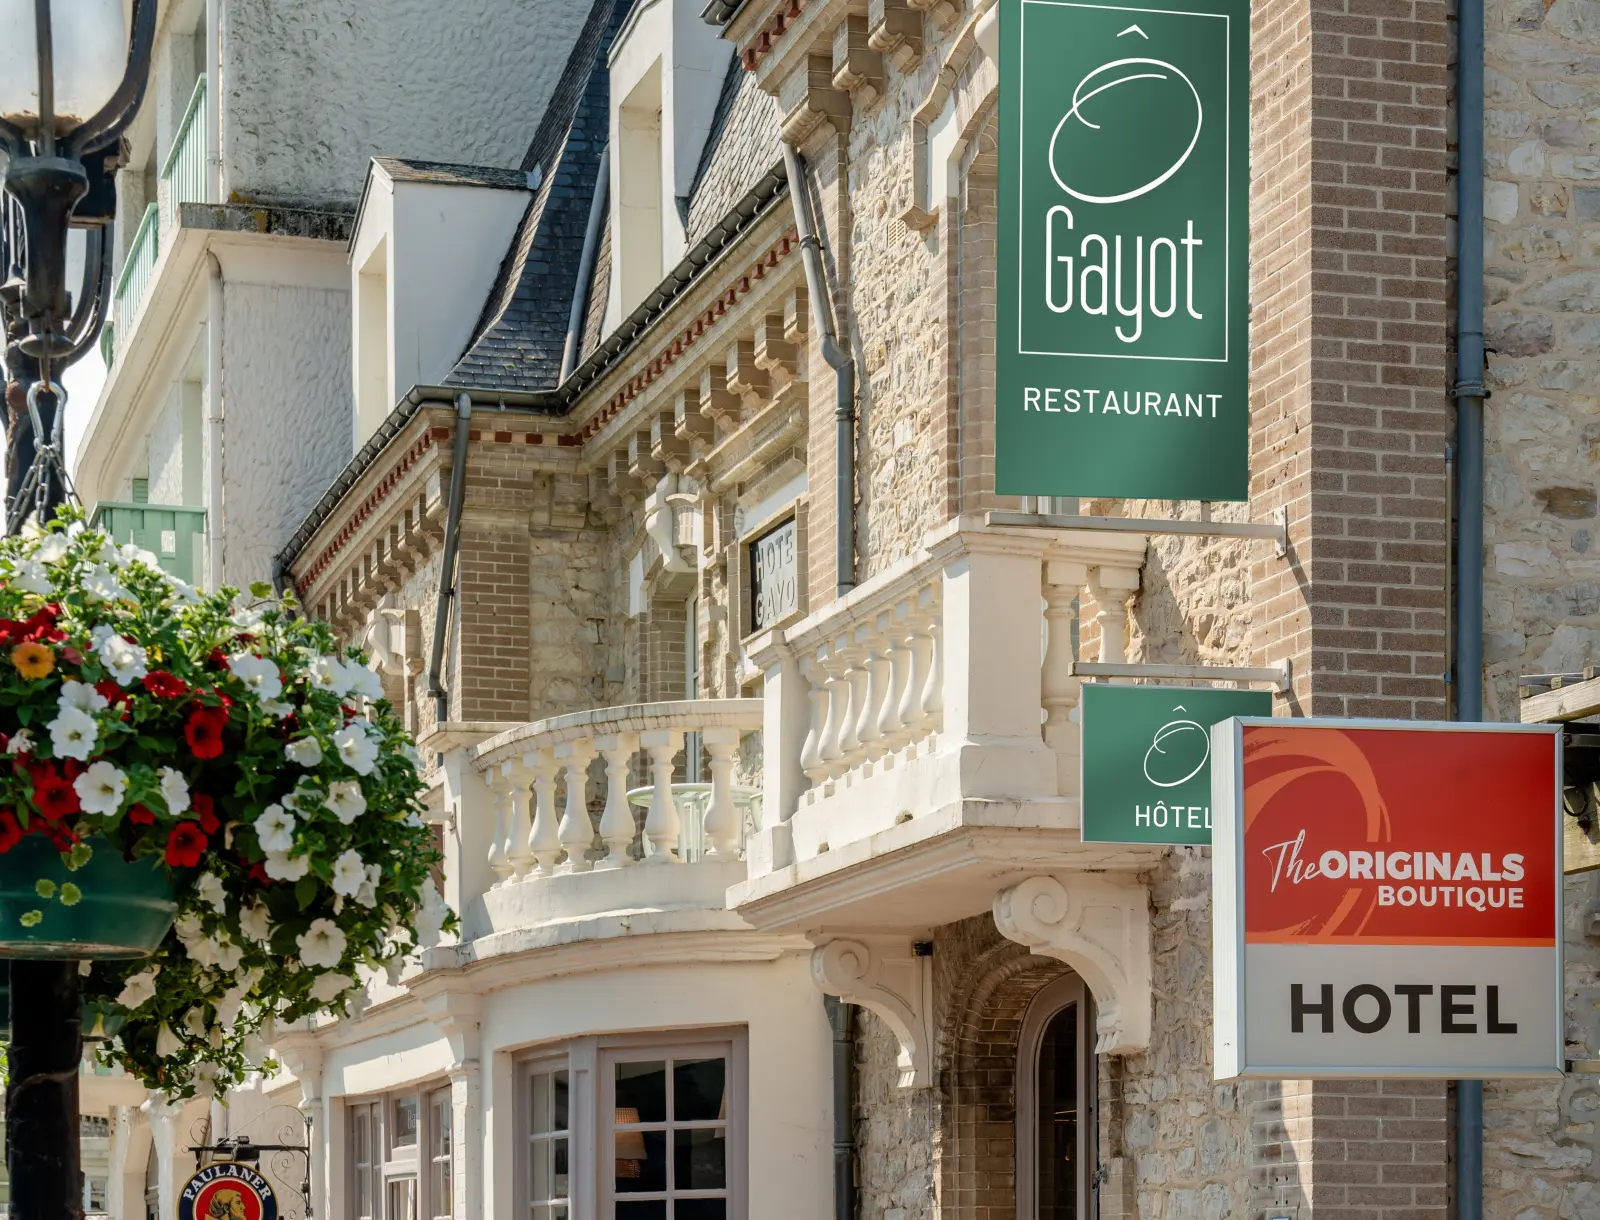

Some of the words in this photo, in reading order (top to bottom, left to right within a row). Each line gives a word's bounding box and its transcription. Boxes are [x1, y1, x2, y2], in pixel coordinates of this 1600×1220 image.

[1045, 204, 1203, 343] Gayot
[1023, 386, 1223, 418] RESTAURANT
[1262, 829, 1322, 893] The
[1318, 850, 1525, 882] ORIGINALS
[1378, 885, 1525, 912] BOUTIQUE
[1290, 983, 1518, 1034] HOTEL
[183, 1164, 272, 1201] PAULANER
